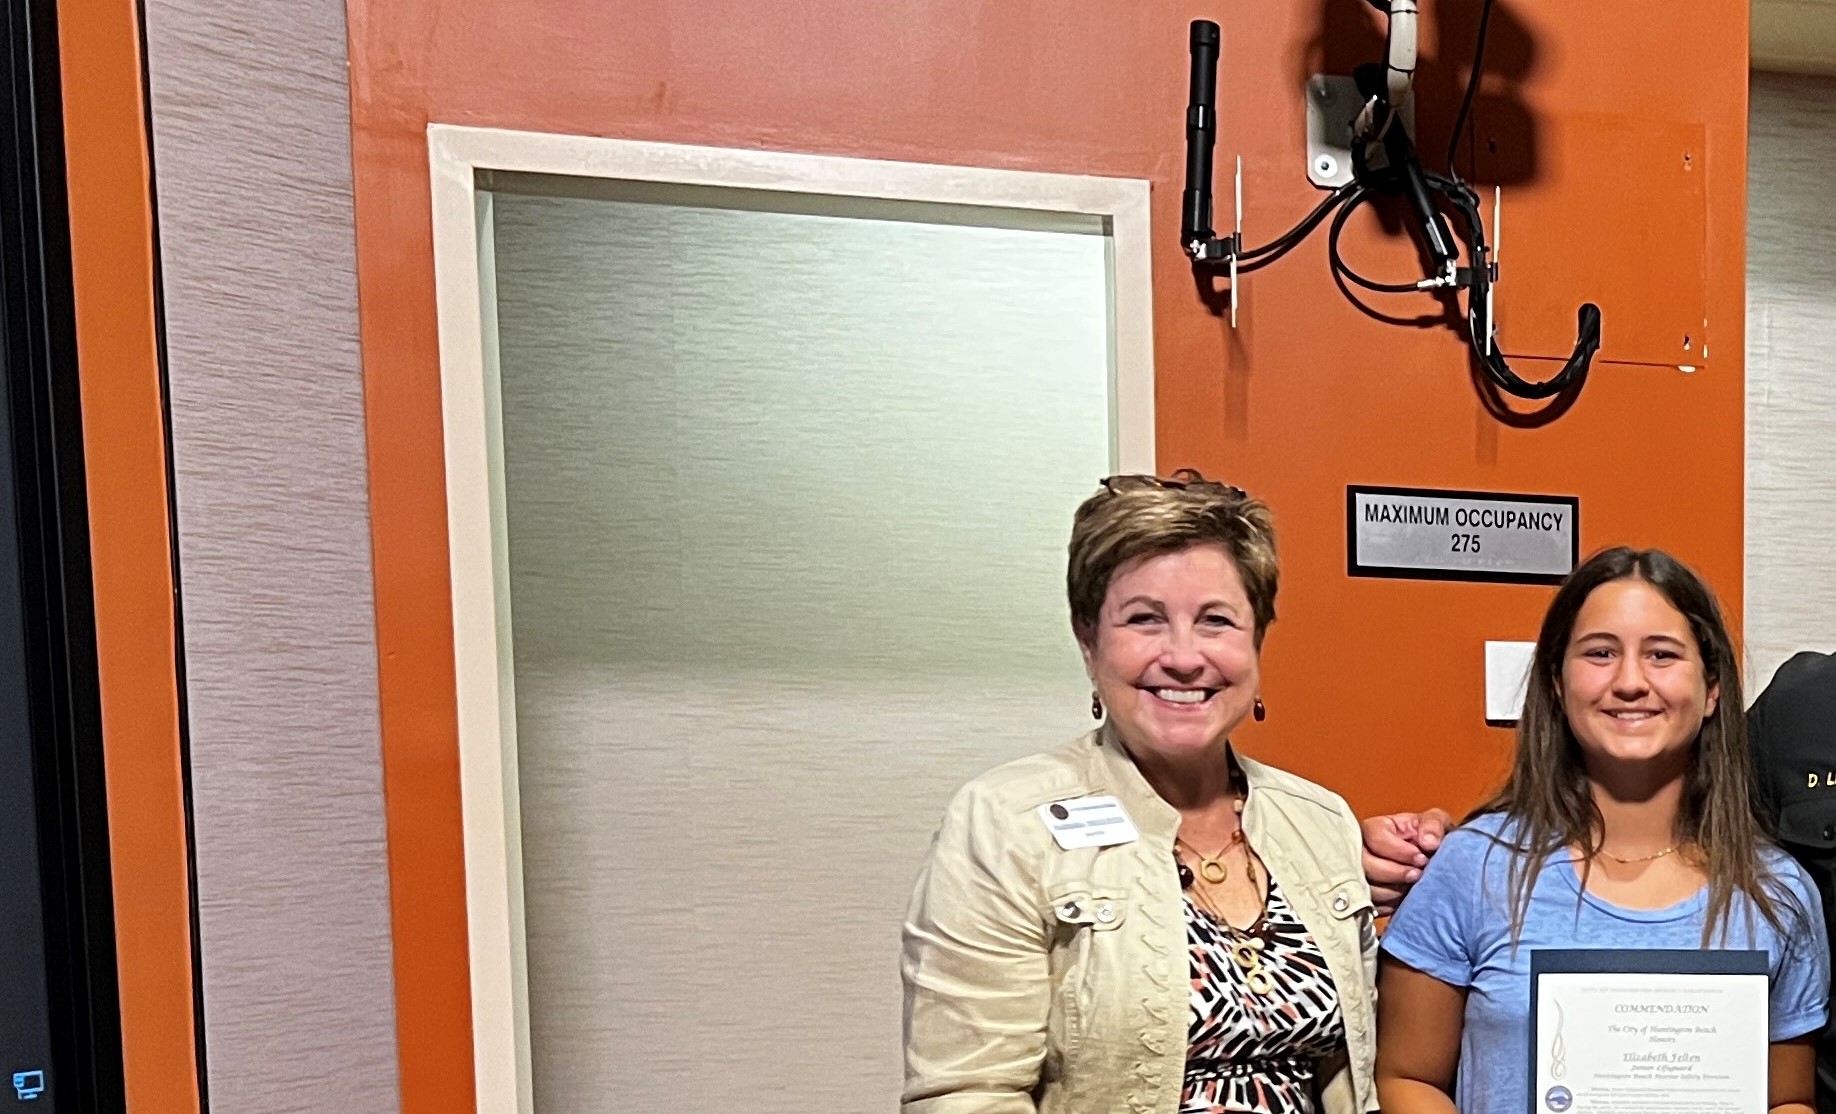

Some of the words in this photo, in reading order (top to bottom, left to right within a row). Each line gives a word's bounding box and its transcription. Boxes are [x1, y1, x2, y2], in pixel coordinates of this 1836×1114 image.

[1365, 503, 1449, 526] MAXIMUM
[1455, 508, 1564, 531] OCCUPANCY
[1451, 534, 1481, 553] 275
[1614, 1004, 1710, 1014] COMMENDATION
[1608, 1025, 1621, 1034] The
[1622, 1025, 1638, 1035] City
[1640, 1025, 1648, 1036] of
[1622, 1052, 1668, 1063] Elizabeth
